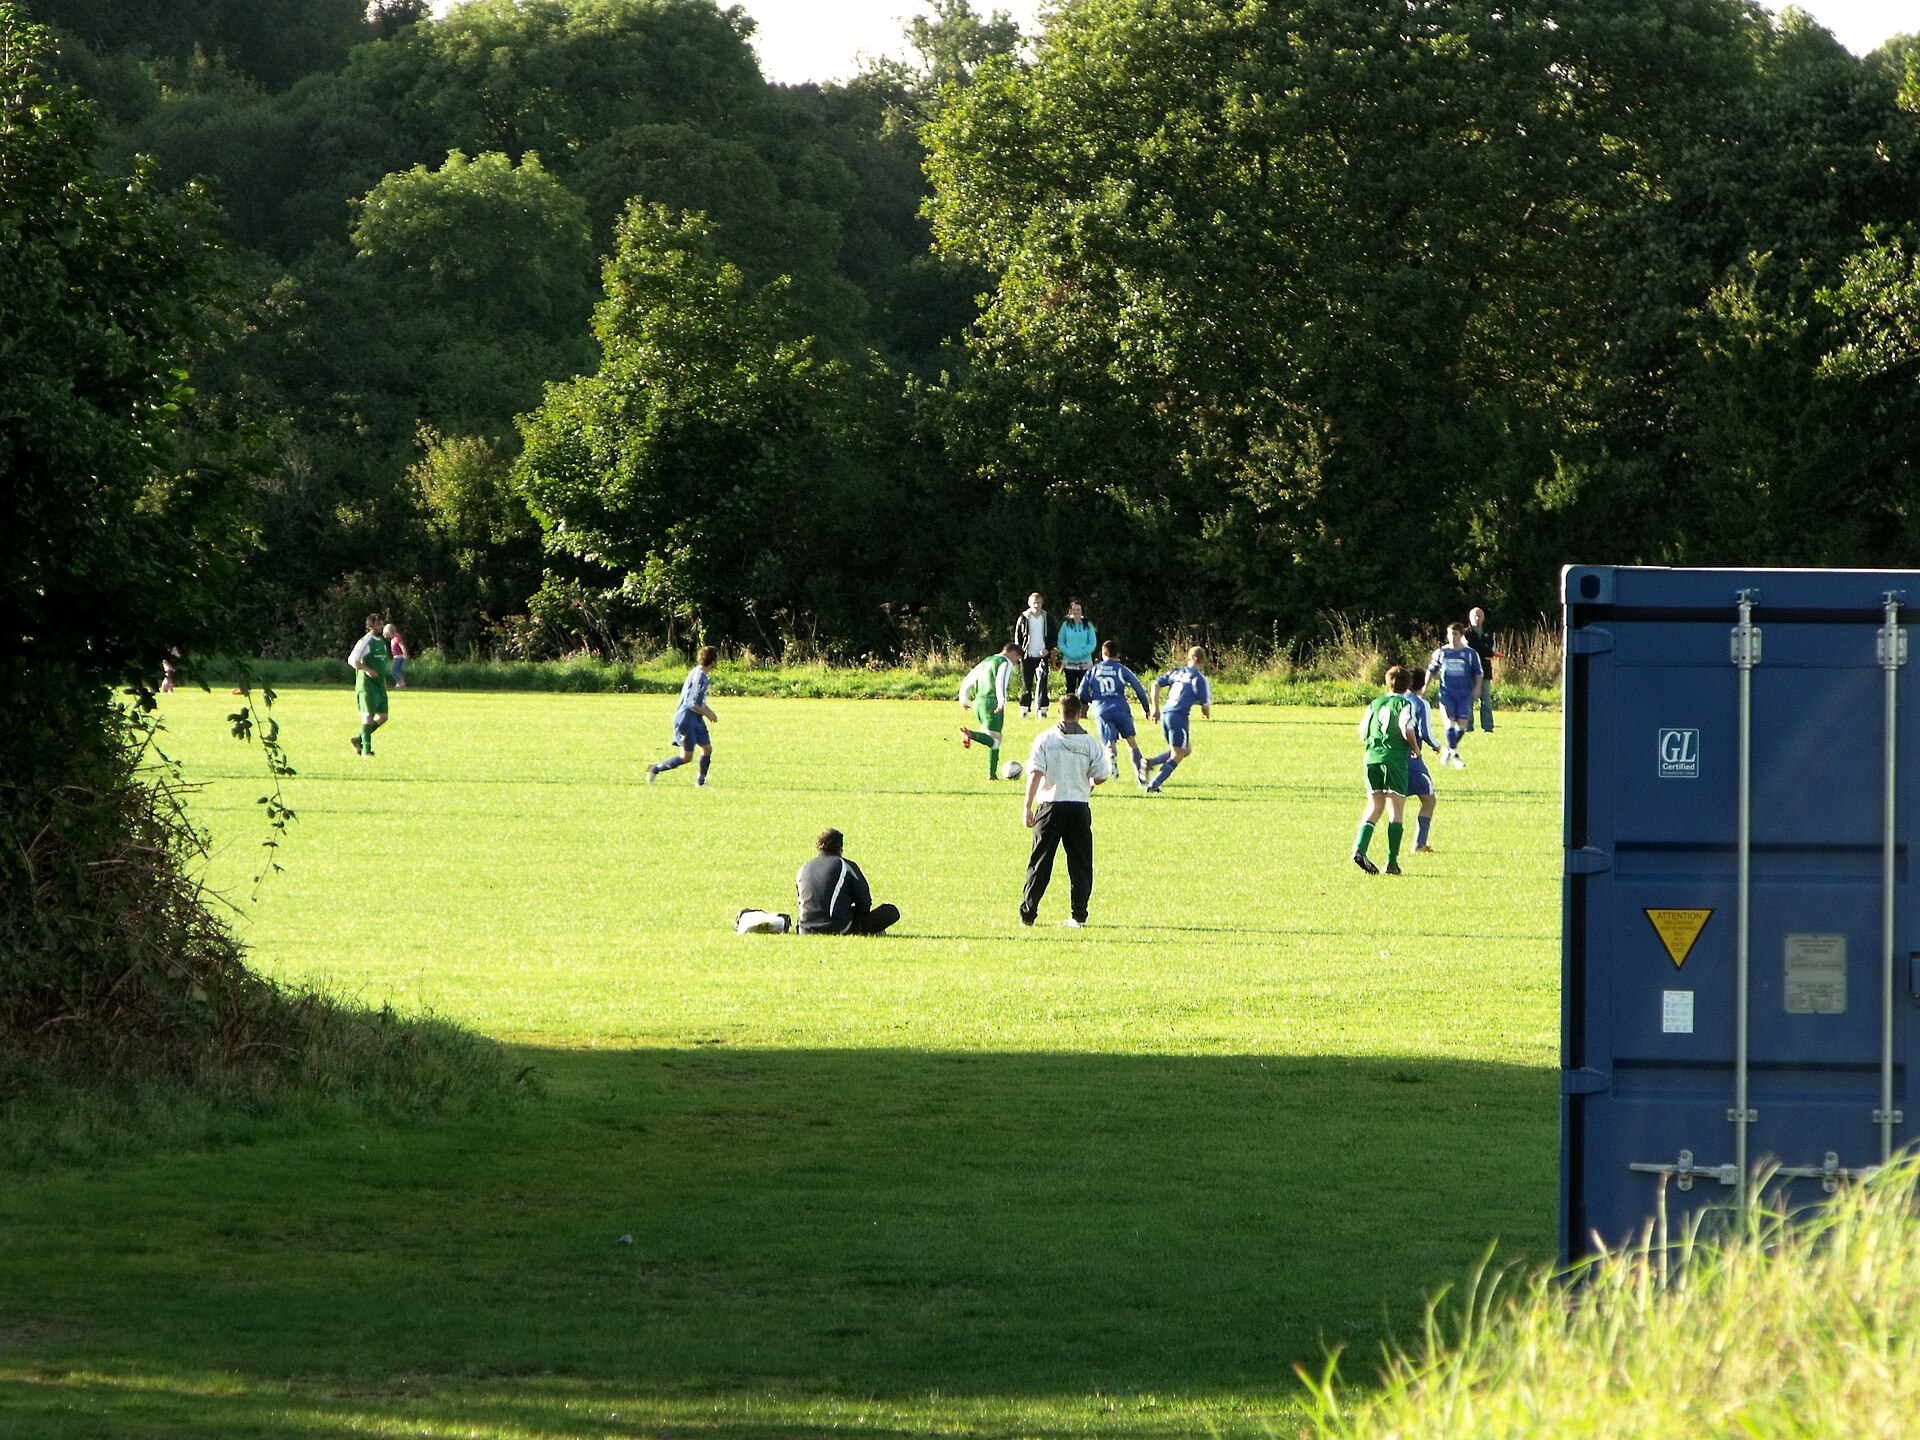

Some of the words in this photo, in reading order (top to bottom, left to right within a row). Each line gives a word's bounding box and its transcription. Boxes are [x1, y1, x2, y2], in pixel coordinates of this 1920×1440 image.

[1096, 676, 1115, 693] 10
[1662, 731, 1696, 762] GL
[1662, 762, 1695, 770] Certified
[1657, 912, 1703, 920] ATTENTION
